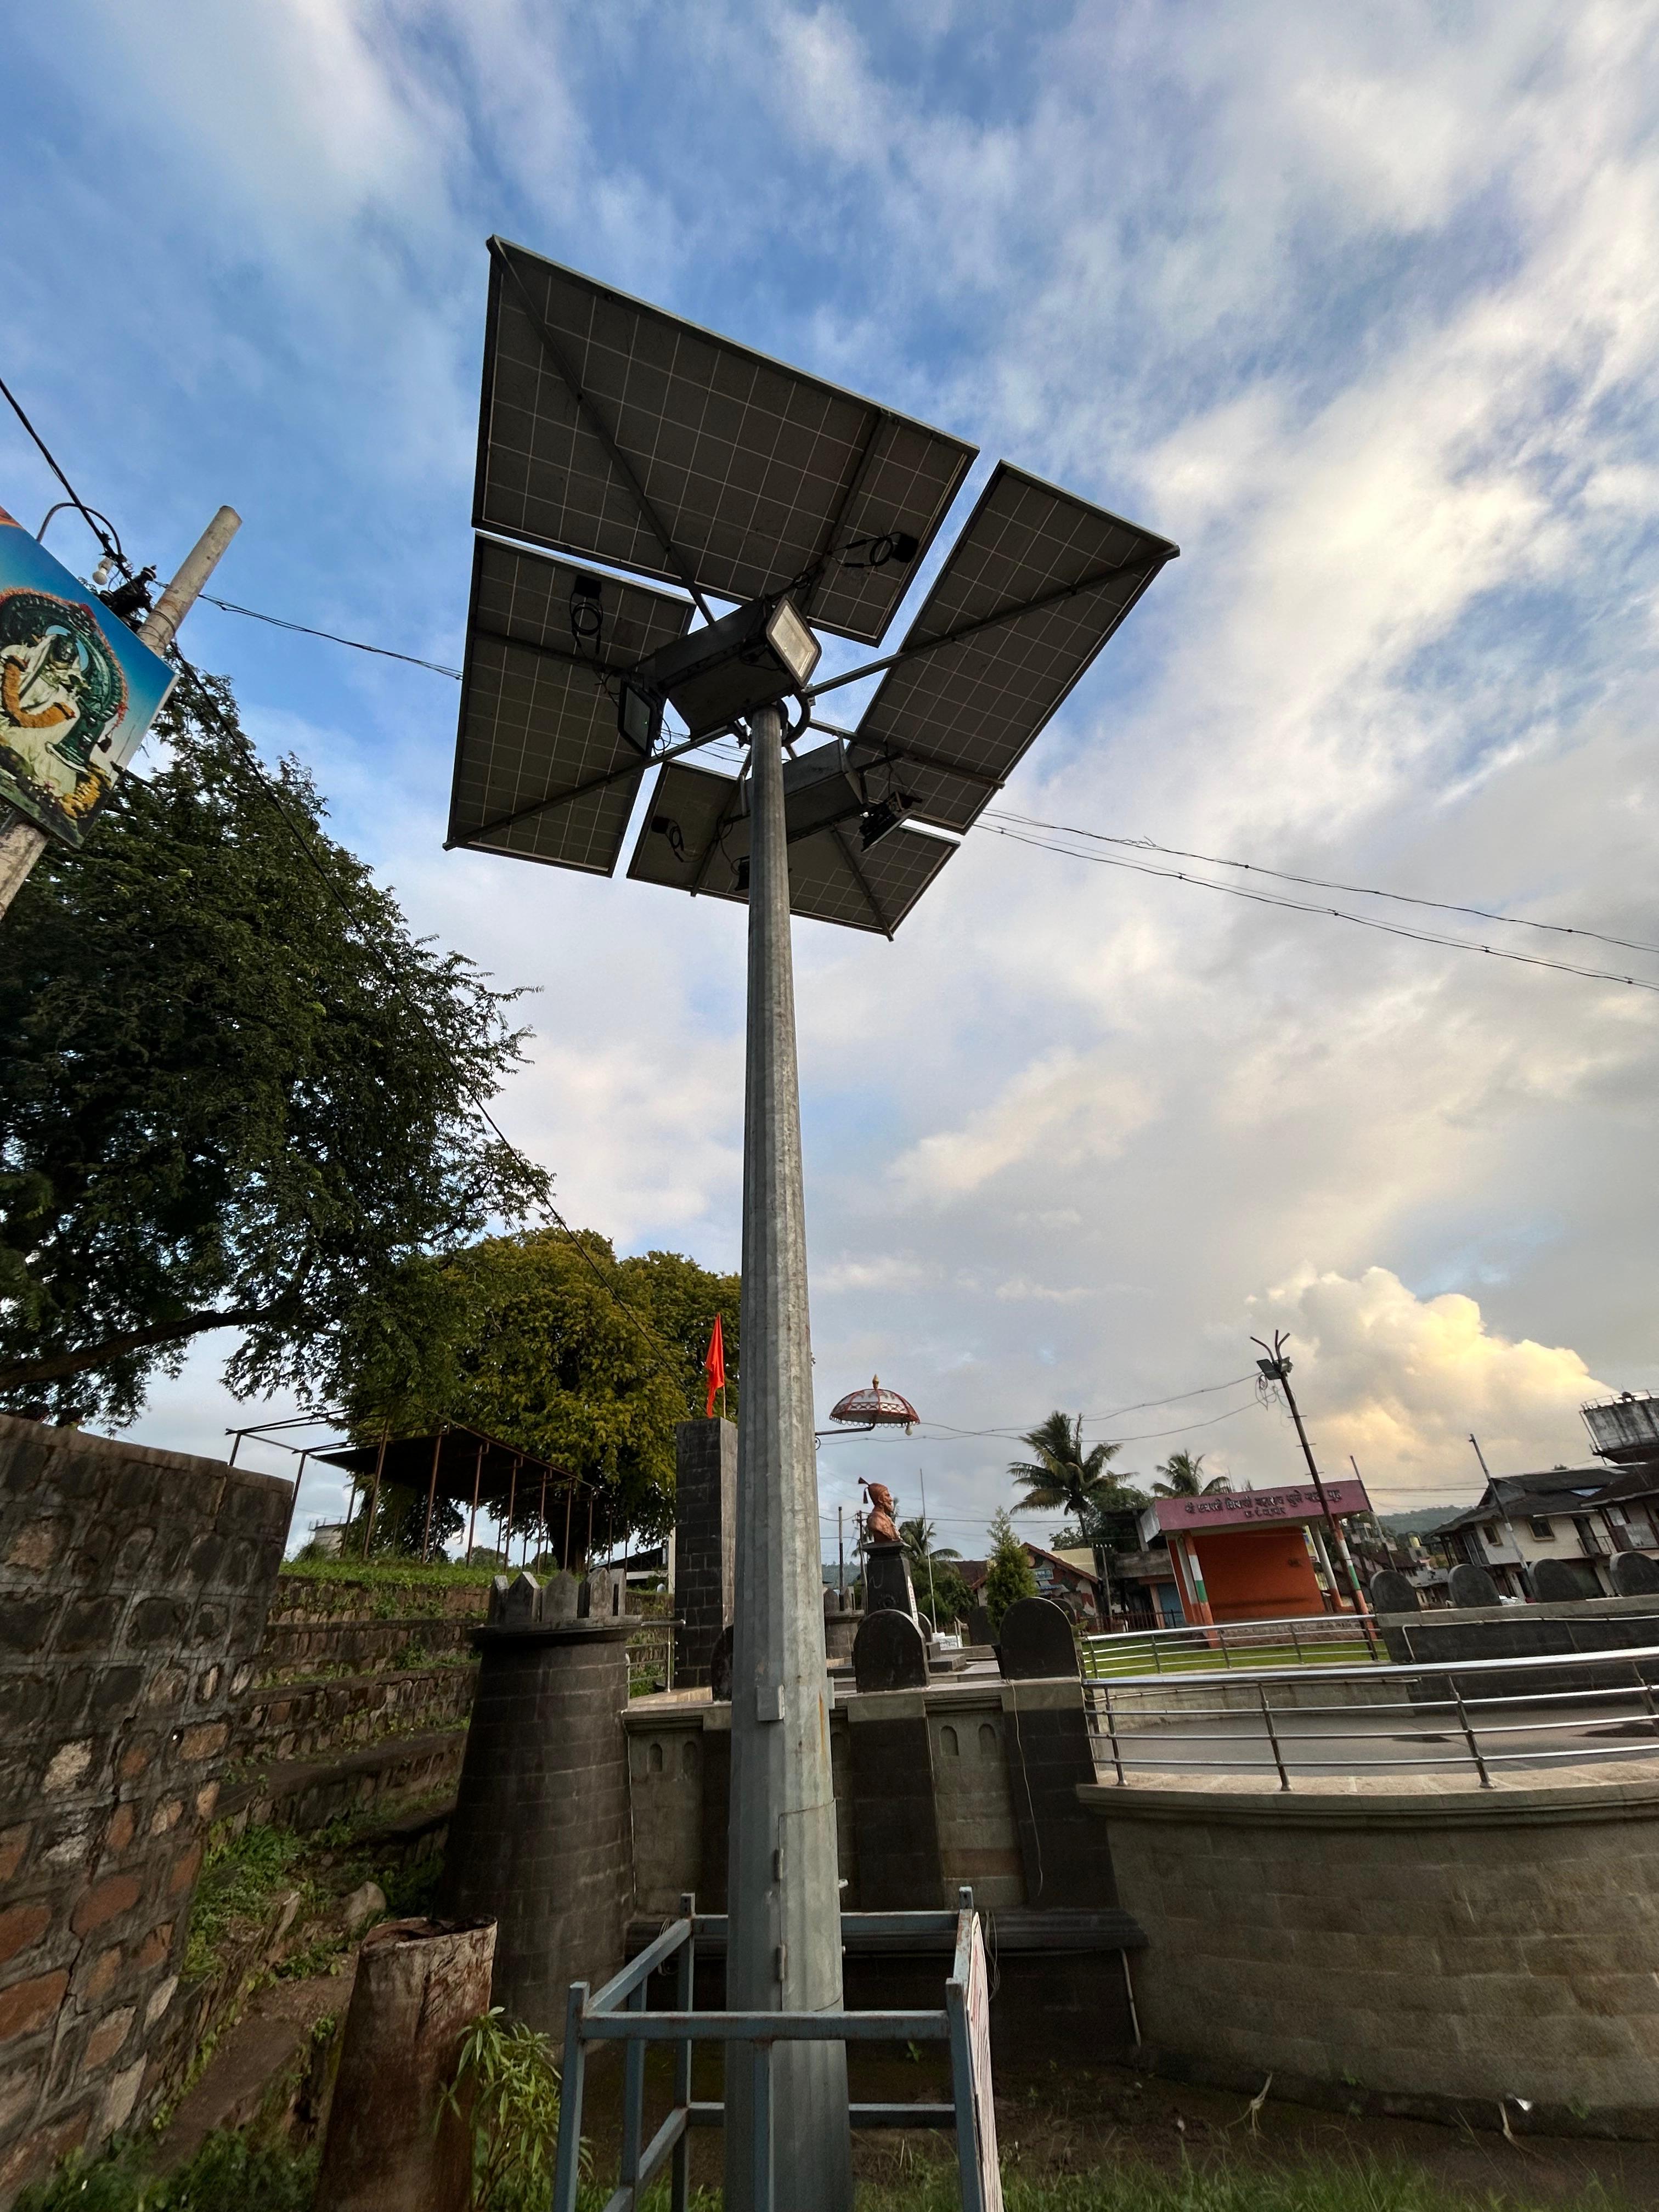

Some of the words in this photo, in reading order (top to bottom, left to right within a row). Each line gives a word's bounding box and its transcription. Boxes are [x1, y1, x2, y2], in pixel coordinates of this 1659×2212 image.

[1185, 1502, 1195, 1513] श्री
[1197, 1499, 1223, 1513] छत्रपती
[1224, 1496, 1253, 1510] शिवाजी
[1255, 1495, 1284, 1507] महाराज
